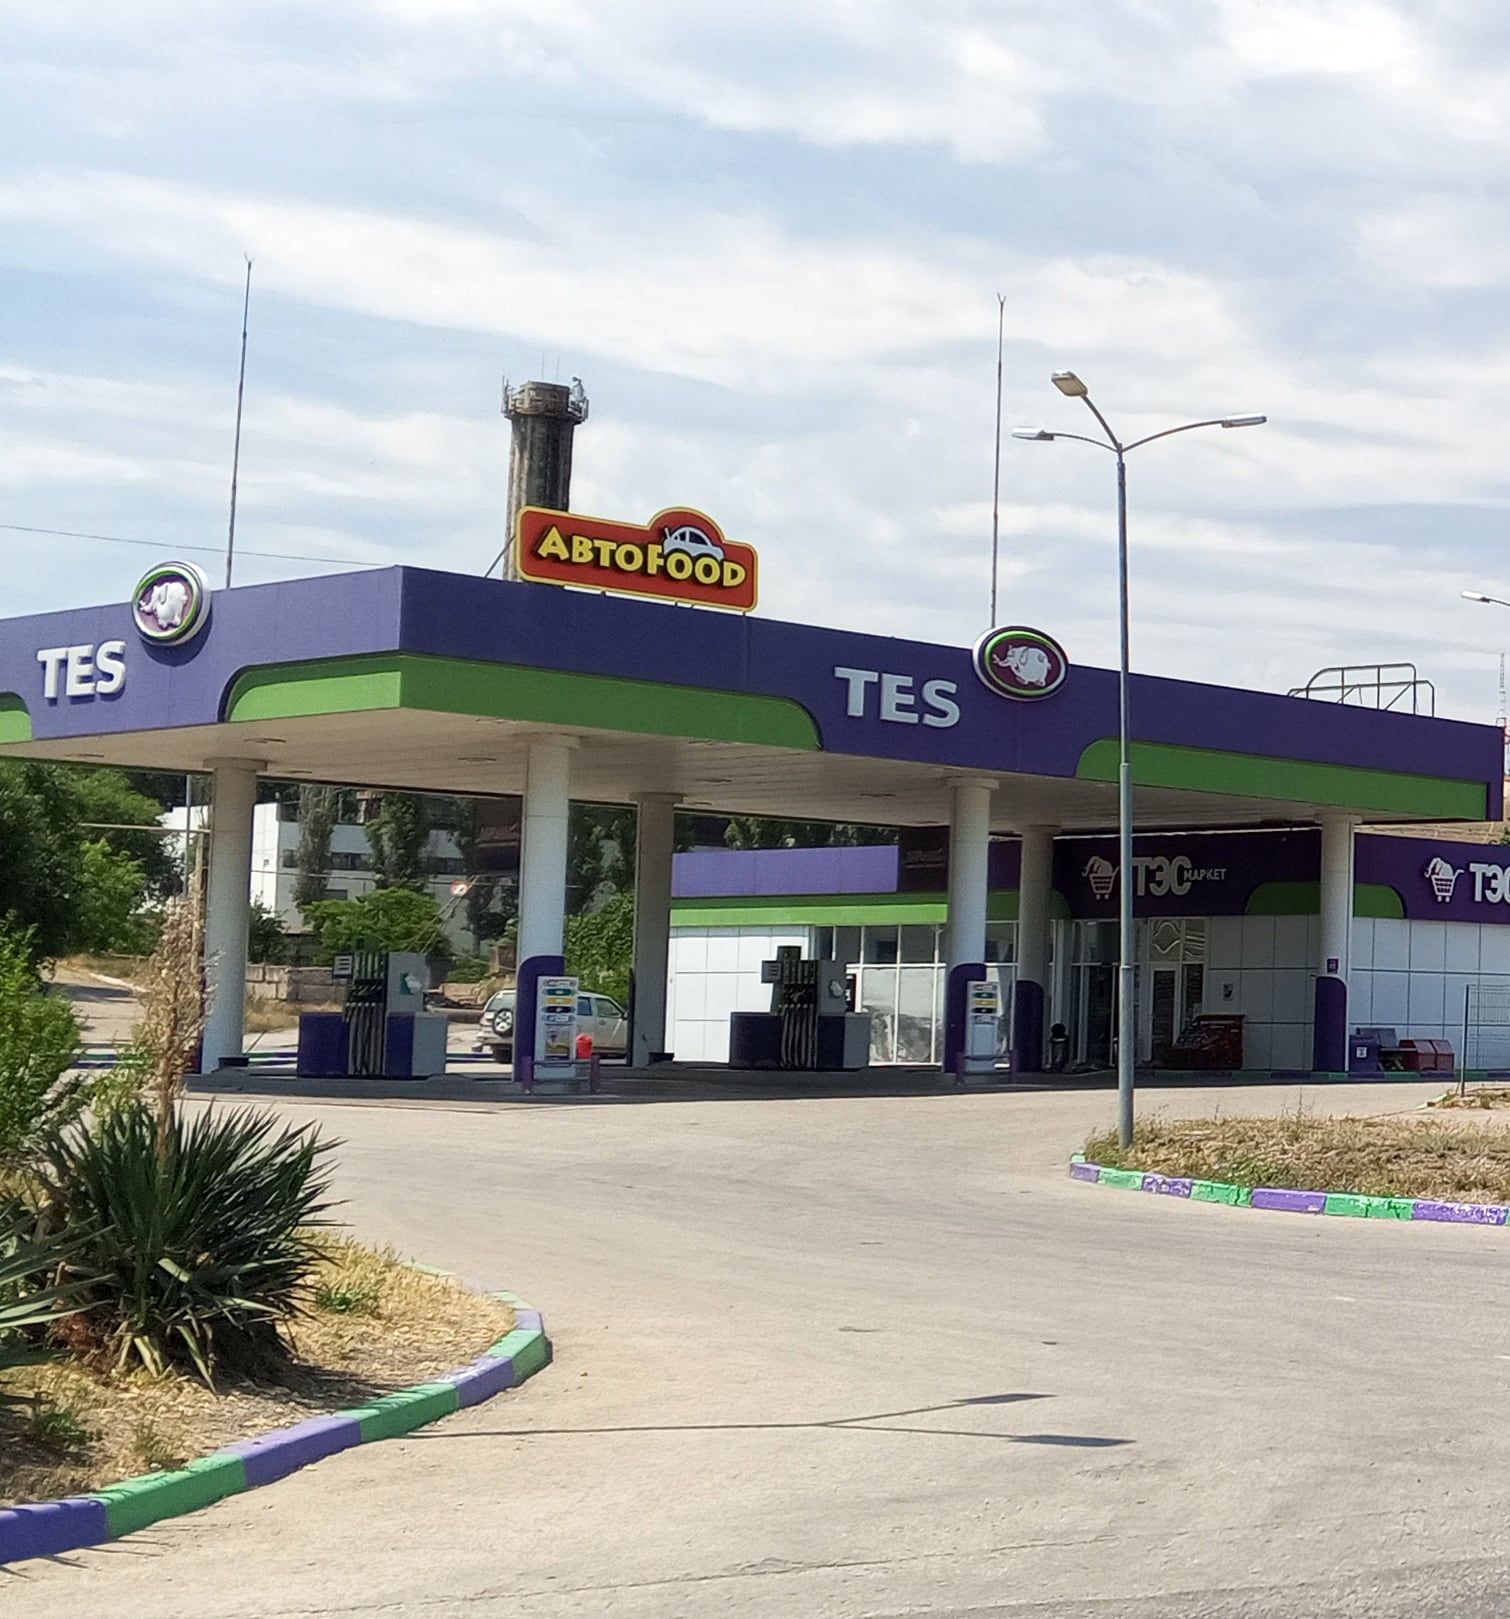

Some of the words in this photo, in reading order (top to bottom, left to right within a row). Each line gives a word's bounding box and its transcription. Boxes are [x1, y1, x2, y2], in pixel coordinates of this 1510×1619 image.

[37, 640, 127, 699] TES
[834, 666, 960, 728] TES
[1132, 855, 1192, 897] ТЭС
[1183, 868, 1228, 882] МАРКЕТ
